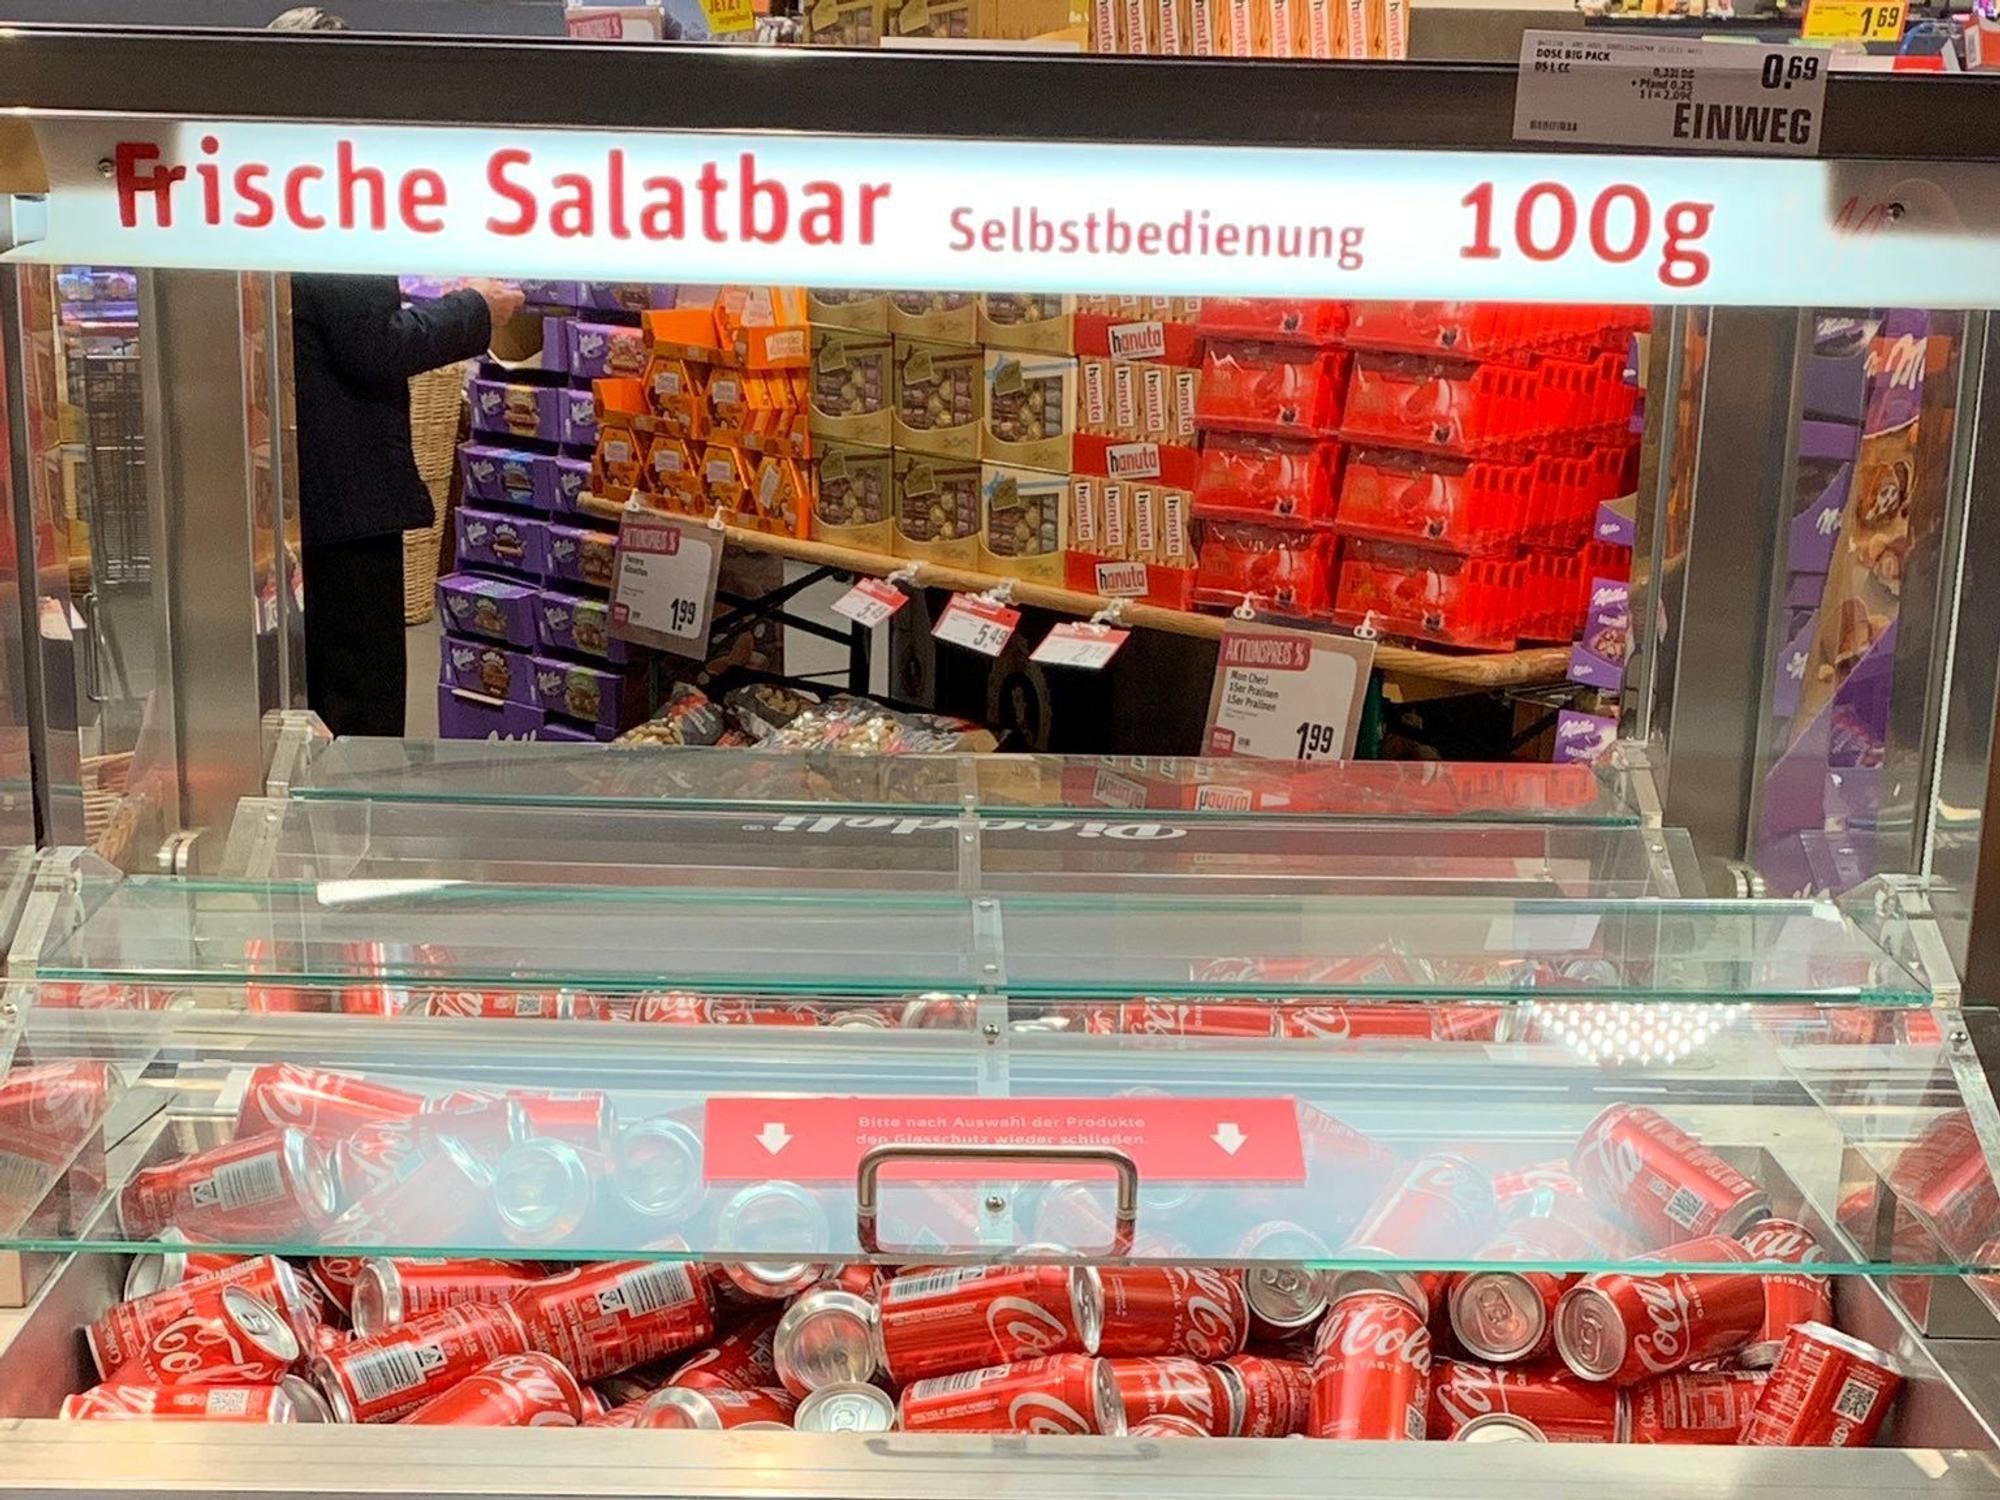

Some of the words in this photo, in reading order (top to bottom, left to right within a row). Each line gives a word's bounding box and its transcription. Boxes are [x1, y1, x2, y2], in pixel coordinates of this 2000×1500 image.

[1860, 7, 1900, 36] 1.69
[1585, 51, 1611, 61] PACK
[1761, 53, 1819, 90] 0.69
[1673, 103, 1811, 145] EINWEG
[115, 135, 448, 234] Frische
[485, 147, 893, 246] Salatbar
[948, 205, 1366, 271] Selbstbedienung
[1460, 180, 1715, 288] 100g
[1111, 325, 1162, 354] hanuta
[1109, 447, 1157, 473] hanuta
[1098, 565, 1145, 590] hanuta
[671, 598, 697, 632] 1.99
[1296, 722, 1334, 760] 1.99
[858, 1116, 900, 1128] Bitte
[906, 1116, 947, 1128] nach
[953, 1116, 1026, 1128] Auswahl
[1031, 1117, 1059, 1128] der
[1066, 1117, 1146, 1129] Produkte
